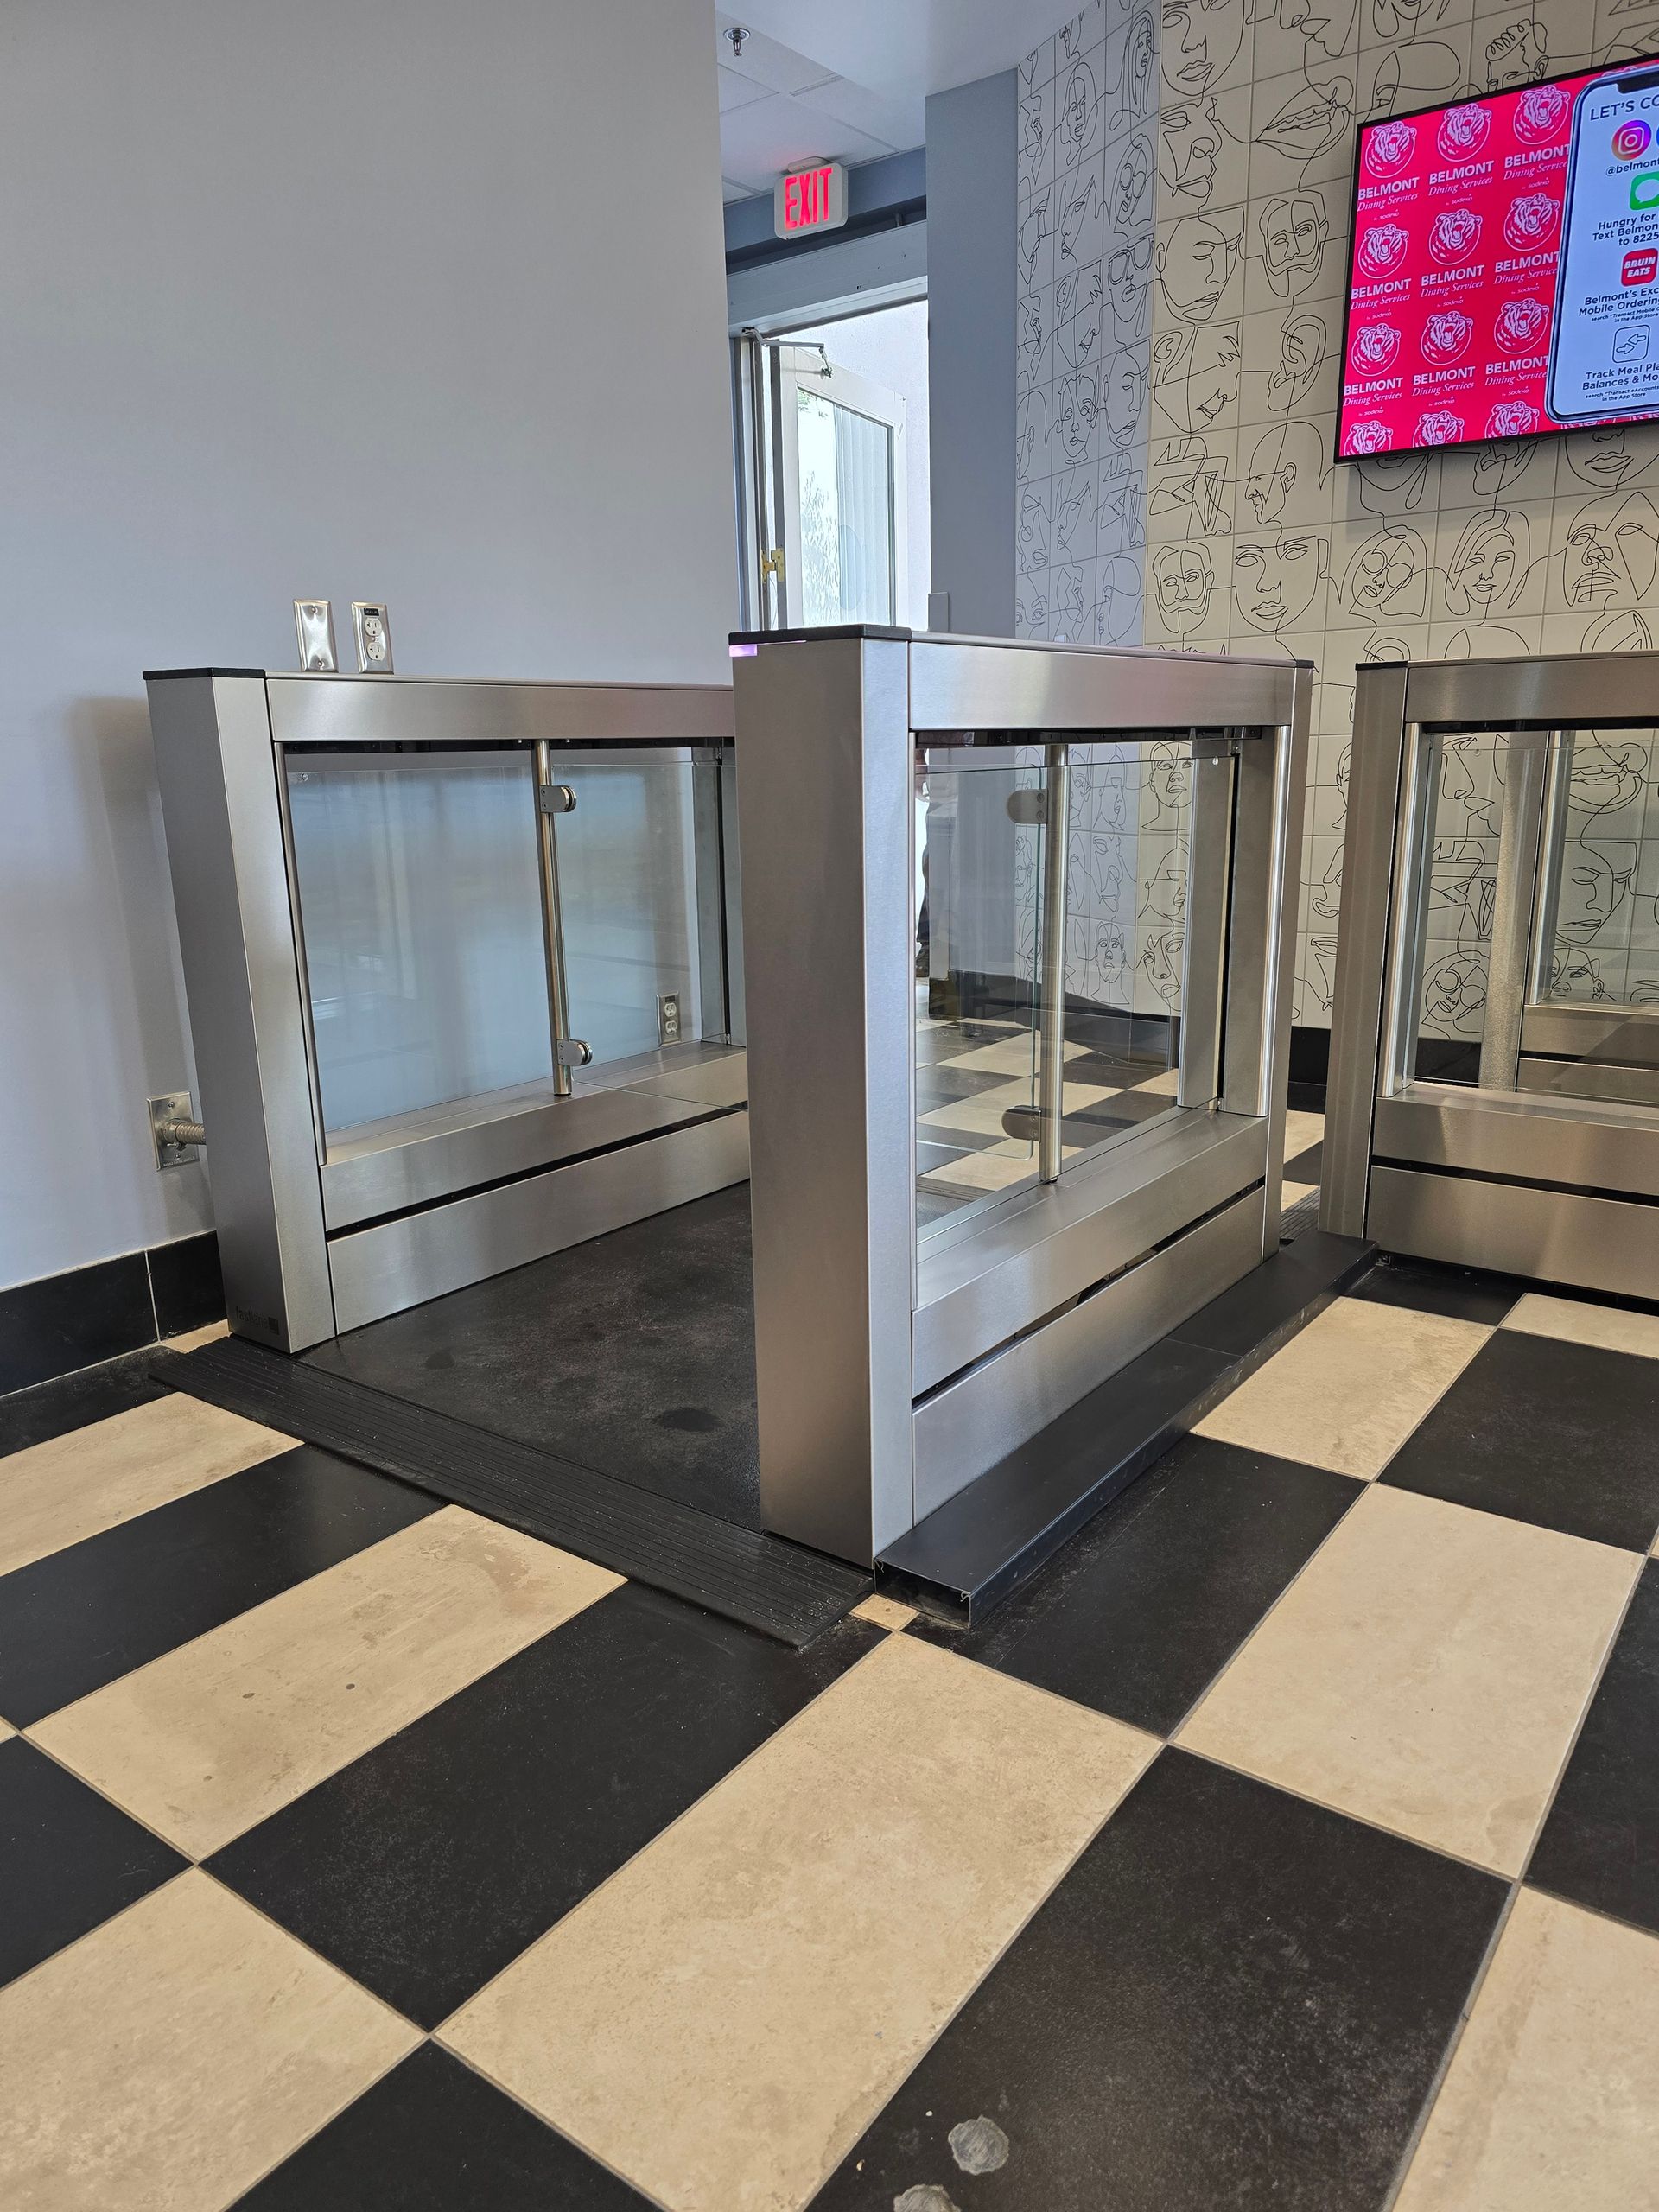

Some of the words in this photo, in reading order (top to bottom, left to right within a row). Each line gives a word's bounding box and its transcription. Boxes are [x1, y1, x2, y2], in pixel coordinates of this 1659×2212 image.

[1590, 100, 1635, 121] LET'S
[1505, 144, 1570, 168] BELMONT
[1429, 161, 1494, 185] BELMONT
[1503, 168, 1535, 180] Dining
[1537, 161, 1568, 173] Service
[1358, 177, 1420, 200] BELMONT
[1428, 184, 1459, 196] Dining
[1460, 177, 1492, 189] Services
[785, 167, 833, 230] EXIT
[1357, 200, 1385, 212] Dining
[1388, 194, 1418, 205] Services
[1599, 217, 1637, 230] Hungry
[1640, 213, 1656, 222] for
[1592, 230, 1614, 241] Text
[1618, 224, 1657, 236] Belmon
[1633, 232, 1659, 243] 8225
[1495, 251, 1559, 272] BELMONT
[1624, 257, 1656, 269] BRUIN
[1421, 264, 1484, 286] BELMONT
[1493, 274, 1525, 284] Dining
[1527, 268, 1557, 278] Service
[1627, 267, 1650, 277] EATS
[1351, 278, 1411, 299] BELMONT
[1421, 287, 1450, 297] Dining
[1452, 281, 1484, 292] Services
[1585, 290, 1637, 305] Belmont's
[1350, 300, 1378, 310] Dining
[1380, 294, 1410, 305] Services
[1579, 304, 1613, 316] Mobile
[1618, 297, 1659, 309] Orderin
[1485, 355, 1548, 374] BELMONT
[1586, 369, 1614, 379] Track
[1618, 365, 1642, 375] Meal
[1413, 366, 1476, 385] BELMONT
[1484, 376, 1515, 385] Dining
[1517, 371, 1548, 381] Service
[1583, 378, 1629, 390] Balances
[1643, 373, 1658, 382] Mo
[1344, 378, 1403, 396] BELMONT
[1412, 386, 1440, 397] Dining
[1443, 381, 1474, 391] Services
[1343, 396, 1370, 406] Dining
[1372, 392, 1402, 403] Services
